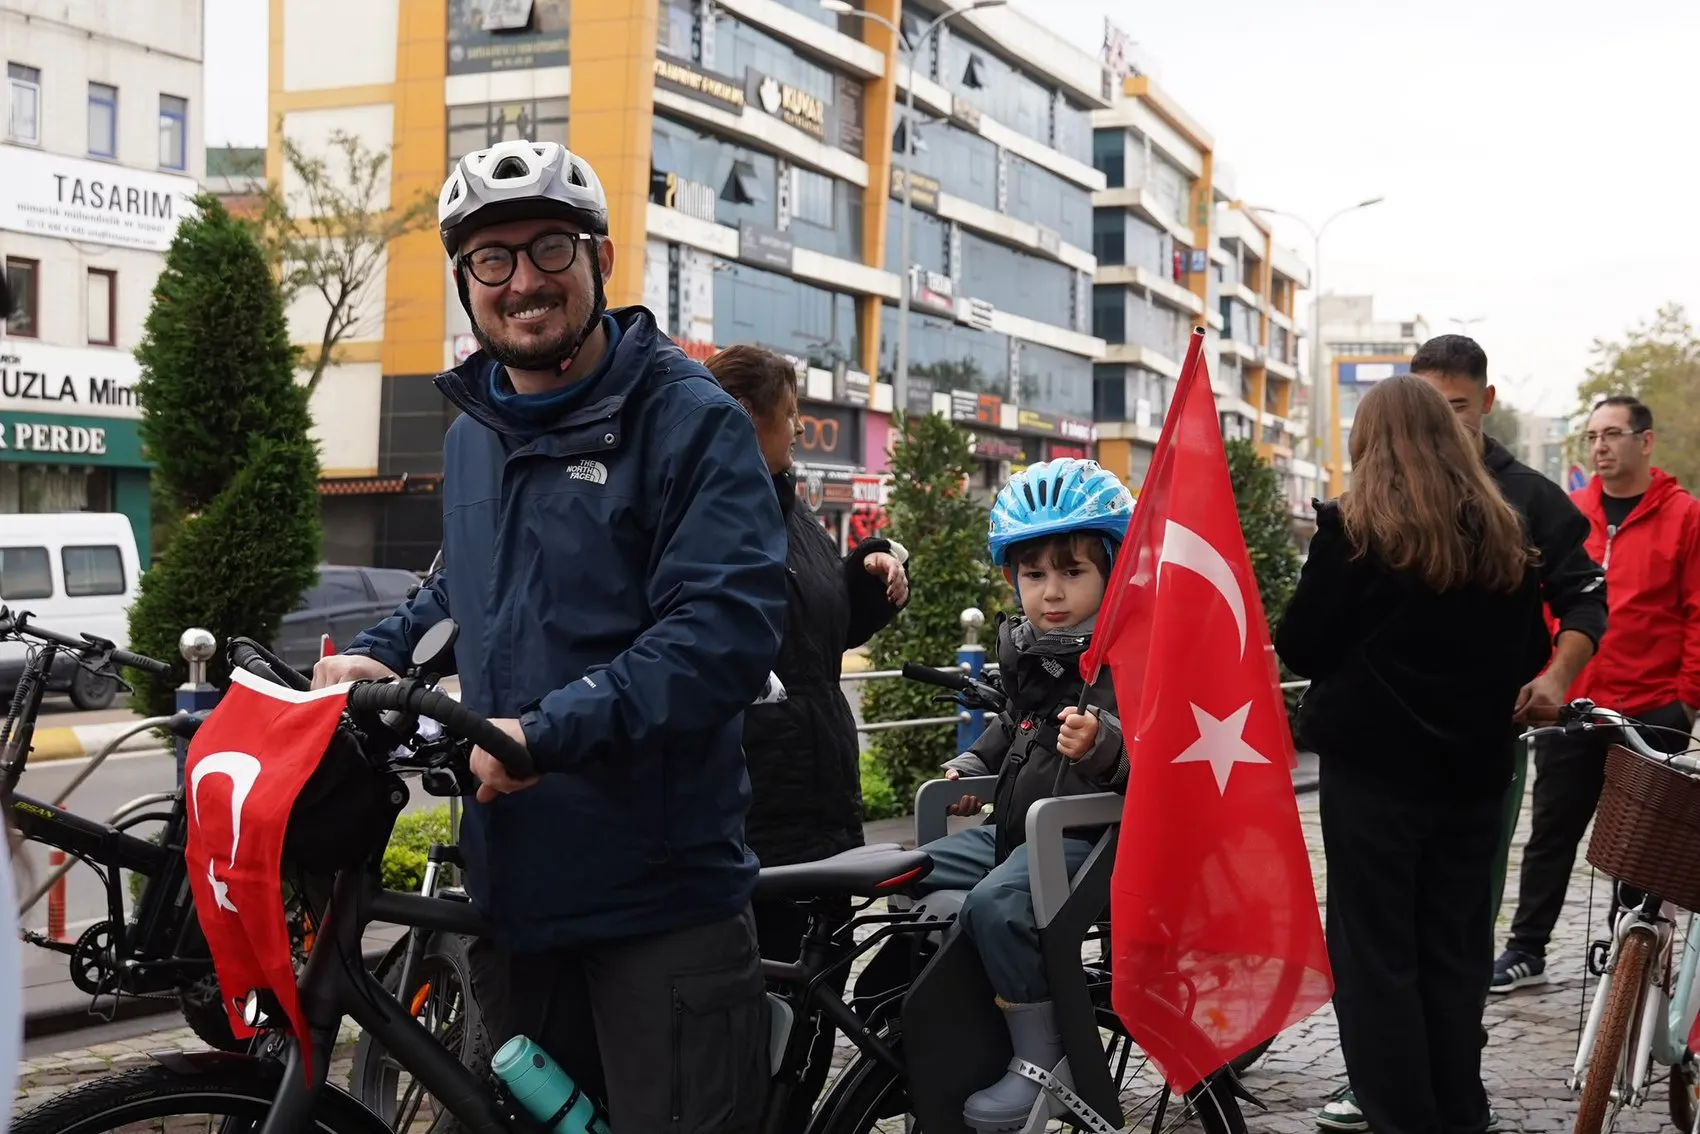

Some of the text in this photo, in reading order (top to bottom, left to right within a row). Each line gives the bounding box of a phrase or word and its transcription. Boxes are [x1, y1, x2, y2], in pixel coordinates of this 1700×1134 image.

[53, 173, 173, 220] TASARIM
[0, 369, 78, 402] UZLA
[13, 422, 107, 455] PERDE
[566, 465, 594, 474] NORTH
[580, 459, 597, 468] THE
[570, 472, 592, 480] FACE
